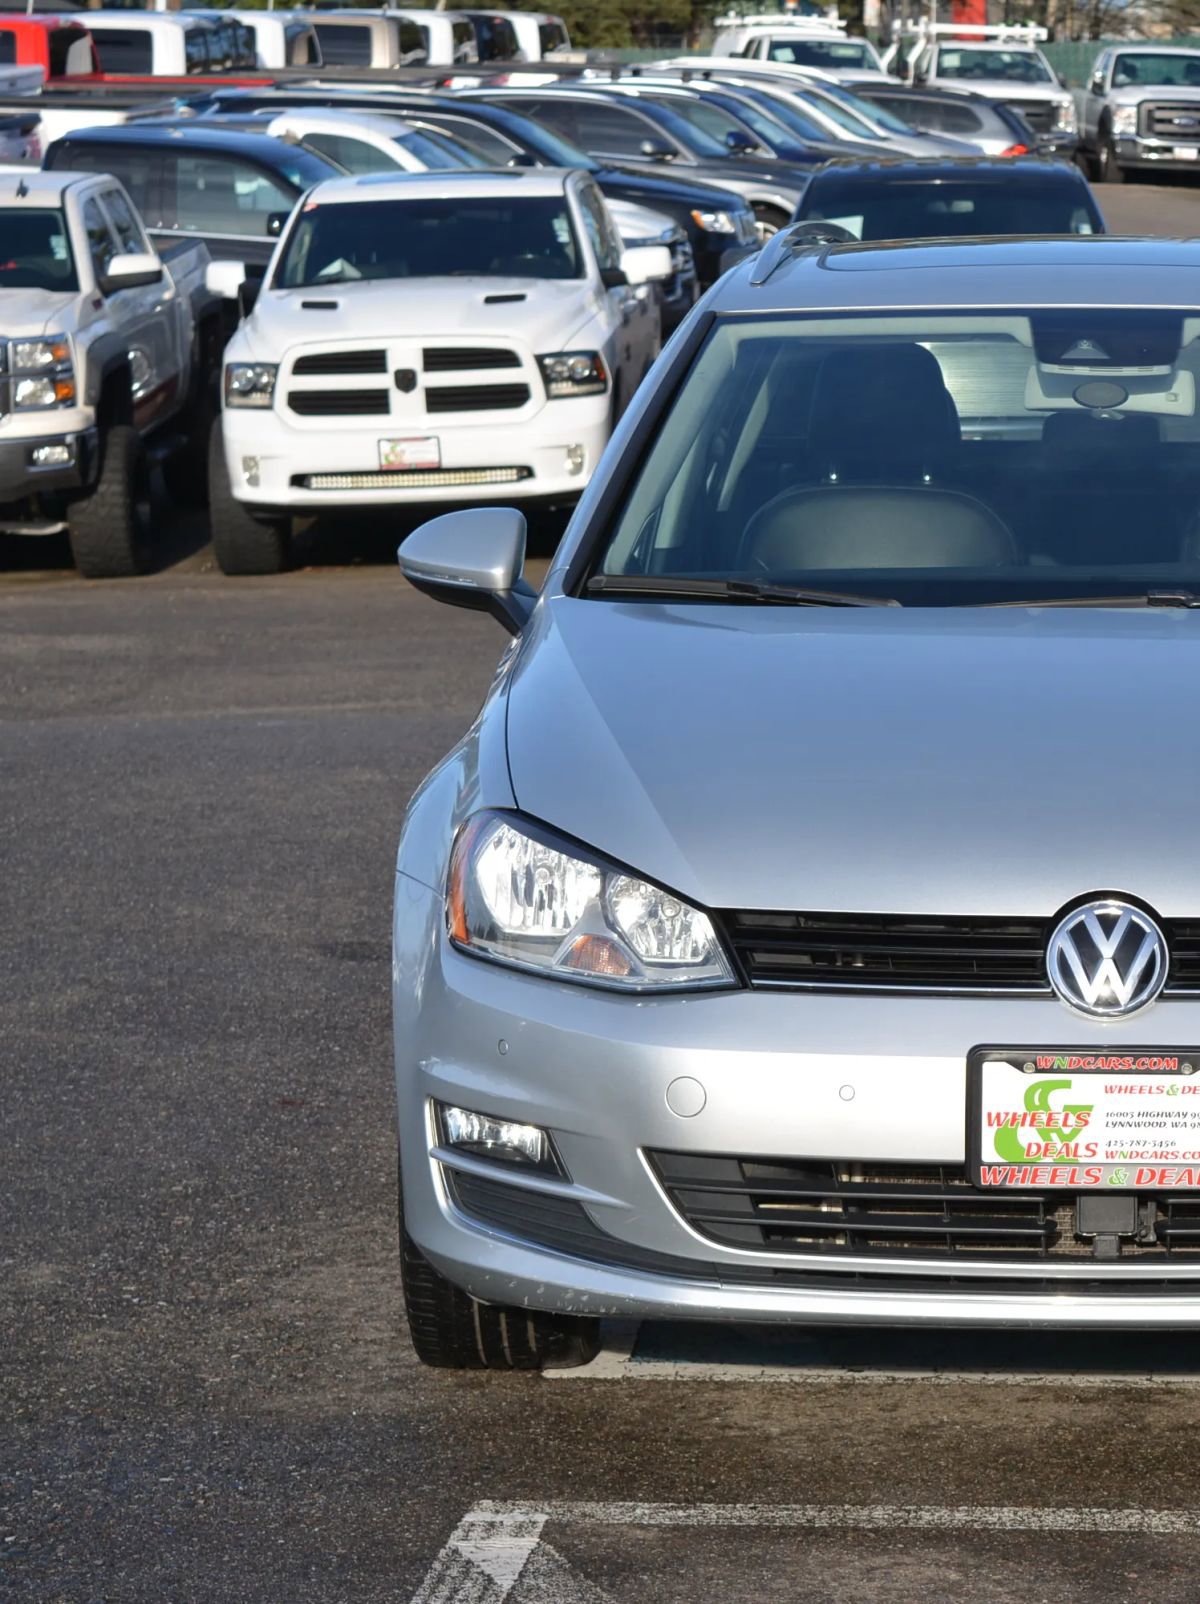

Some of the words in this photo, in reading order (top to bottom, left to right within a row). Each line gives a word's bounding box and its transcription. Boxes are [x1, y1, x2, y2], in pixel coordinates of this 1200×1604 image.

[1036, 1055, 1178, 1071] WNDCARS.COM
[986, 1111, 1092, 1128] WHEELS
[1137, 1111, 1188, 1119] HIGHWAY
[1024, 1142, 1099, 1159] DEALS
[980, 1166, 1104, 1185] WHEELS
[1108, 1167, 1128, 1186] &
